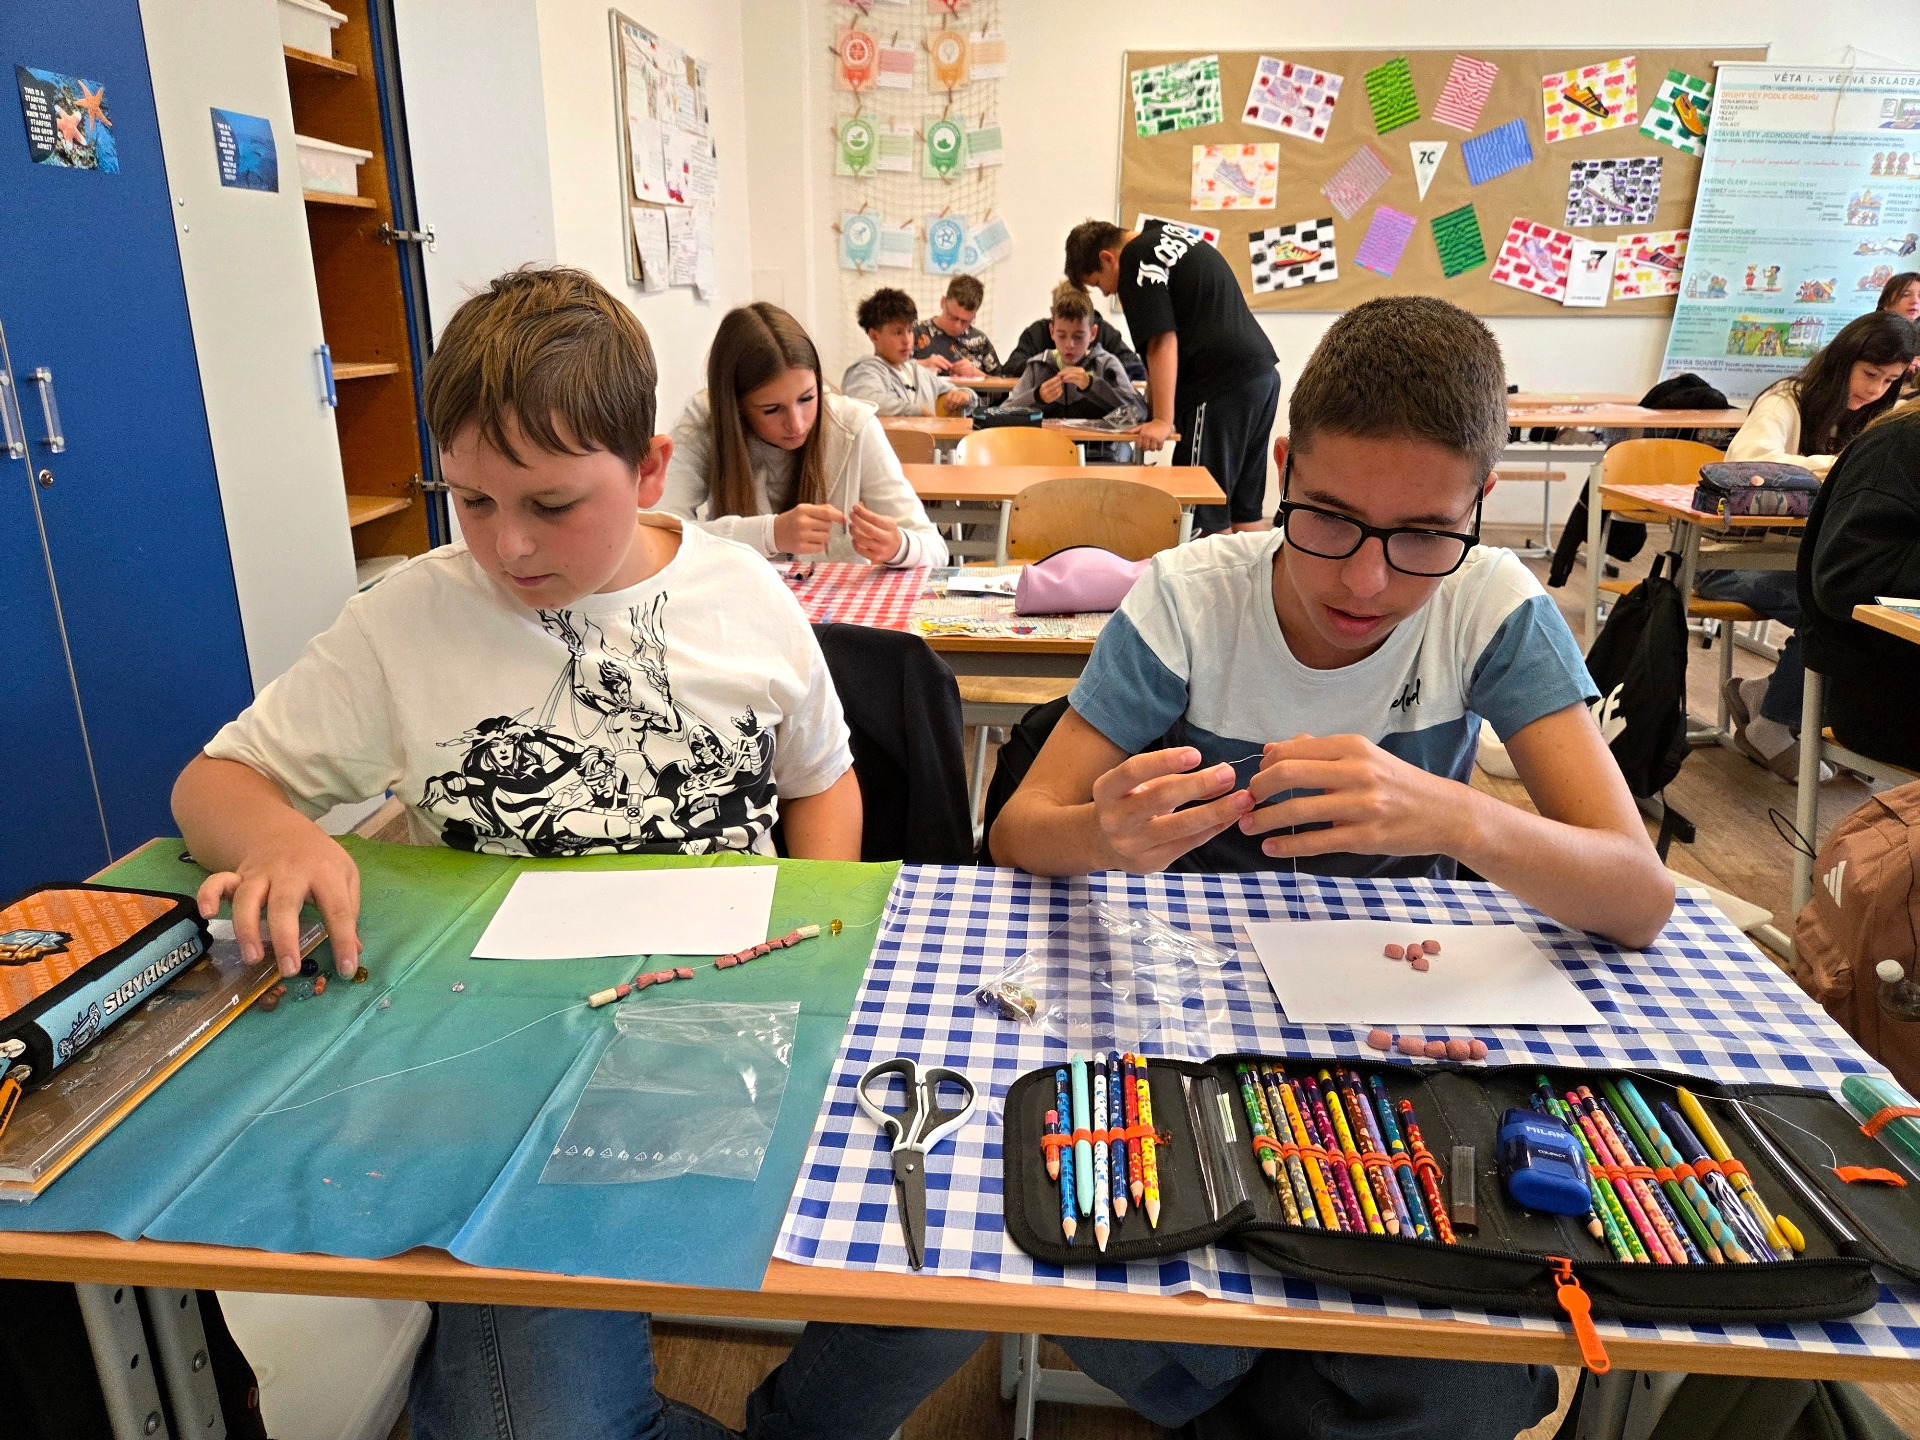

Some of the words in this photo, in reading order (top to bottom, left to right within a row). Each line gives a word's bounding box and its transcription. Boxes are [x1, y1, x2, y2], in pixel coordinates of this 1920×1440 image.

[1774, 72, 1801, 82] VĚTA
[103, 939, 199, 1016] SIRYAKARI
[1525, 1125, 1566, 1140] MILAN
